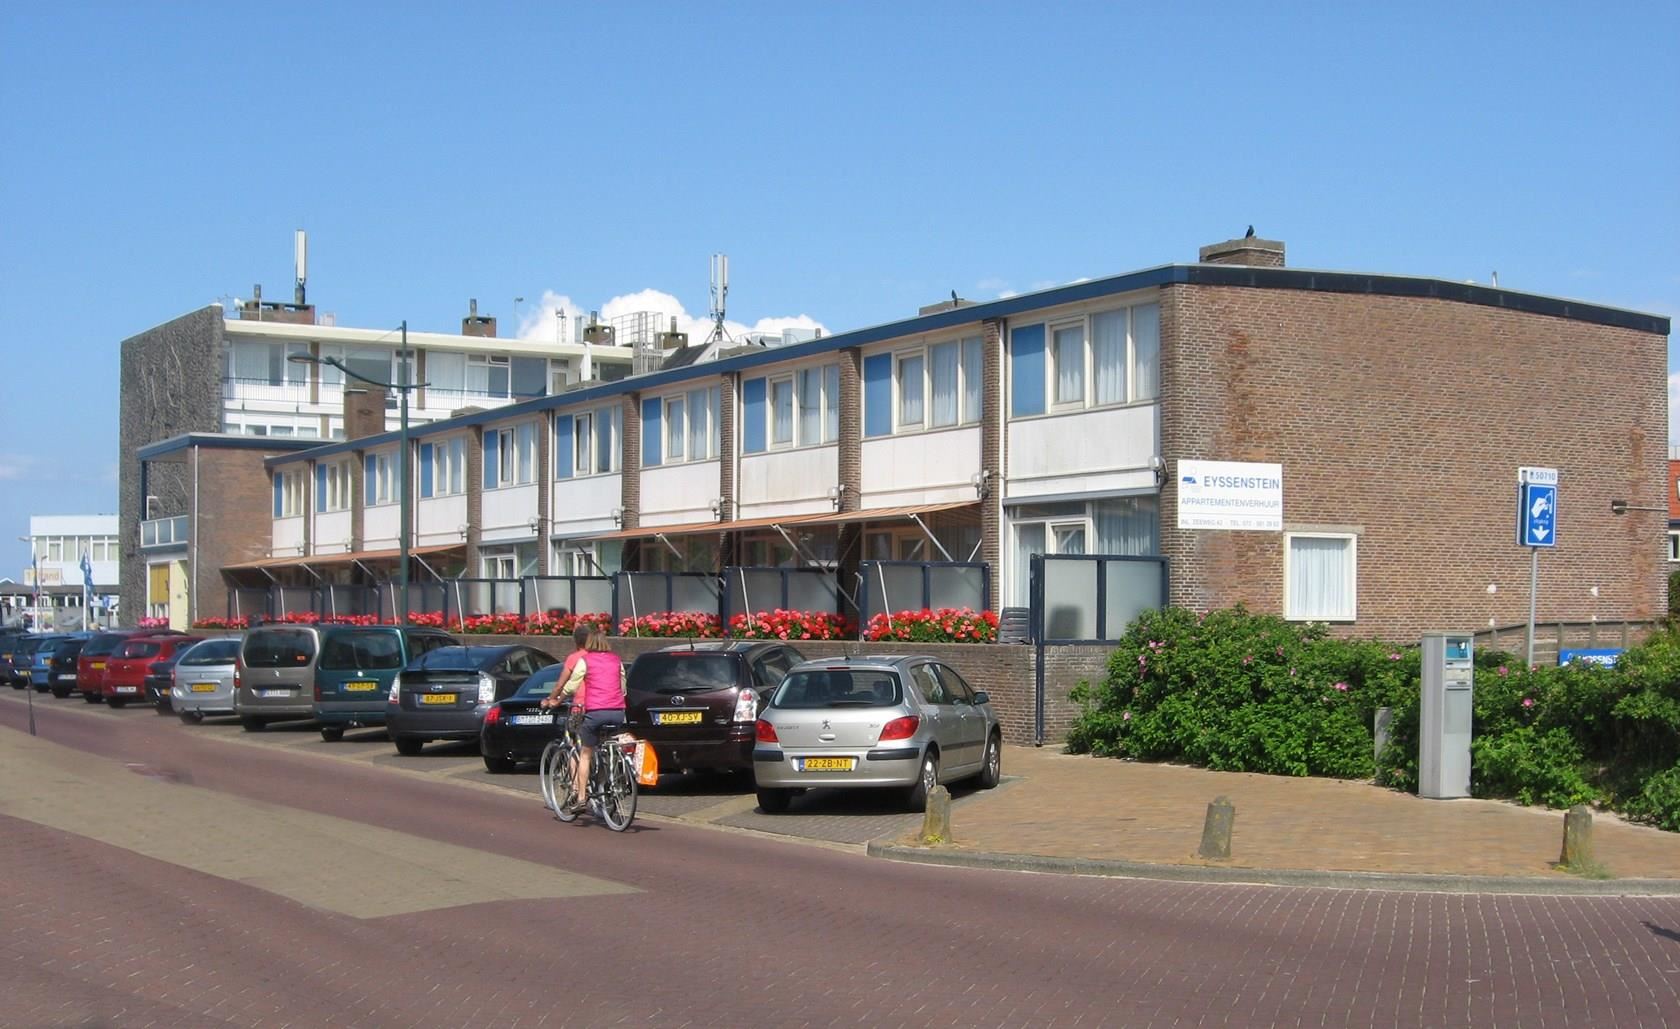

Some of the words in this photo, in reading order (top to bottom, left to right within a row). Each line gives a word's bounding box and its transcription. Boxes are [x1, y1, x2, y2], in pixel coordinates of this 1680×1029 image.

[1204, 475, 1280, 489] EYSSENSTEIN
[1181, 498, 1279, 508] APPARTEMENTENVERHUUR
[807, 758, 849, 768] 22-ZB-NT
